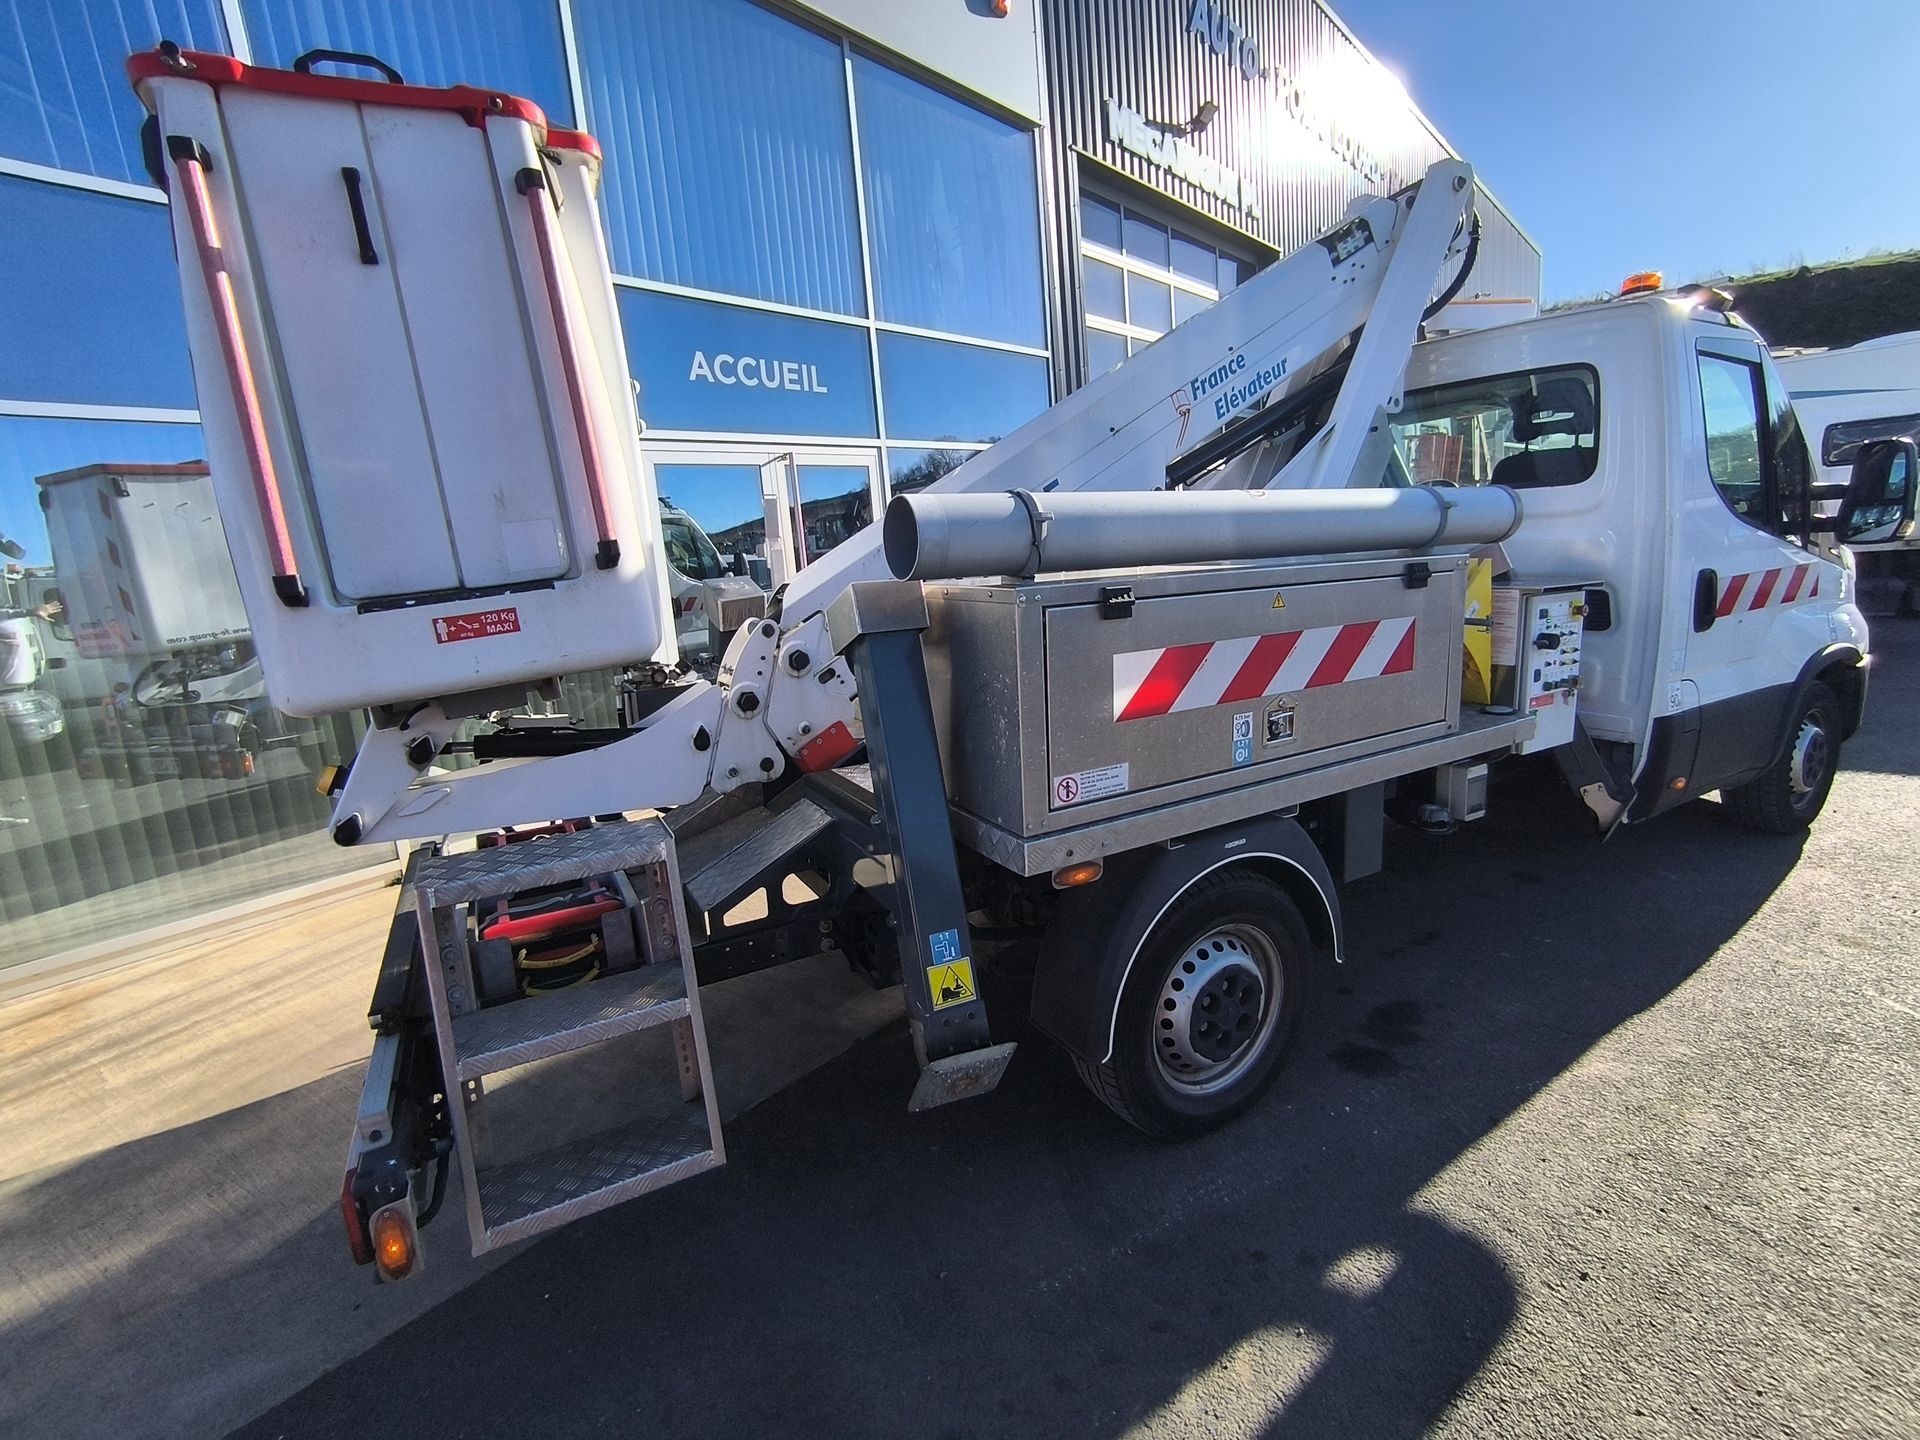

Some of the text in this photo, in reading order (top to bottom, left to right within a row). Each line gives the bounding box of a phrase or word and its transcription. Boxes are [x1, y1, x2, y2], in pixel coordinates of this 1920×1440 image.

[1188, 0, 1259, 81] AUTO
[689, 351, 828, 393] ACCUEIL
[1190, 353, 1246, 401] France
[1214, 357, 1288, 420] Elévateur
[481, 611, 515, 623] 120 Kg
[486, 622, 514, 634] MAXI
